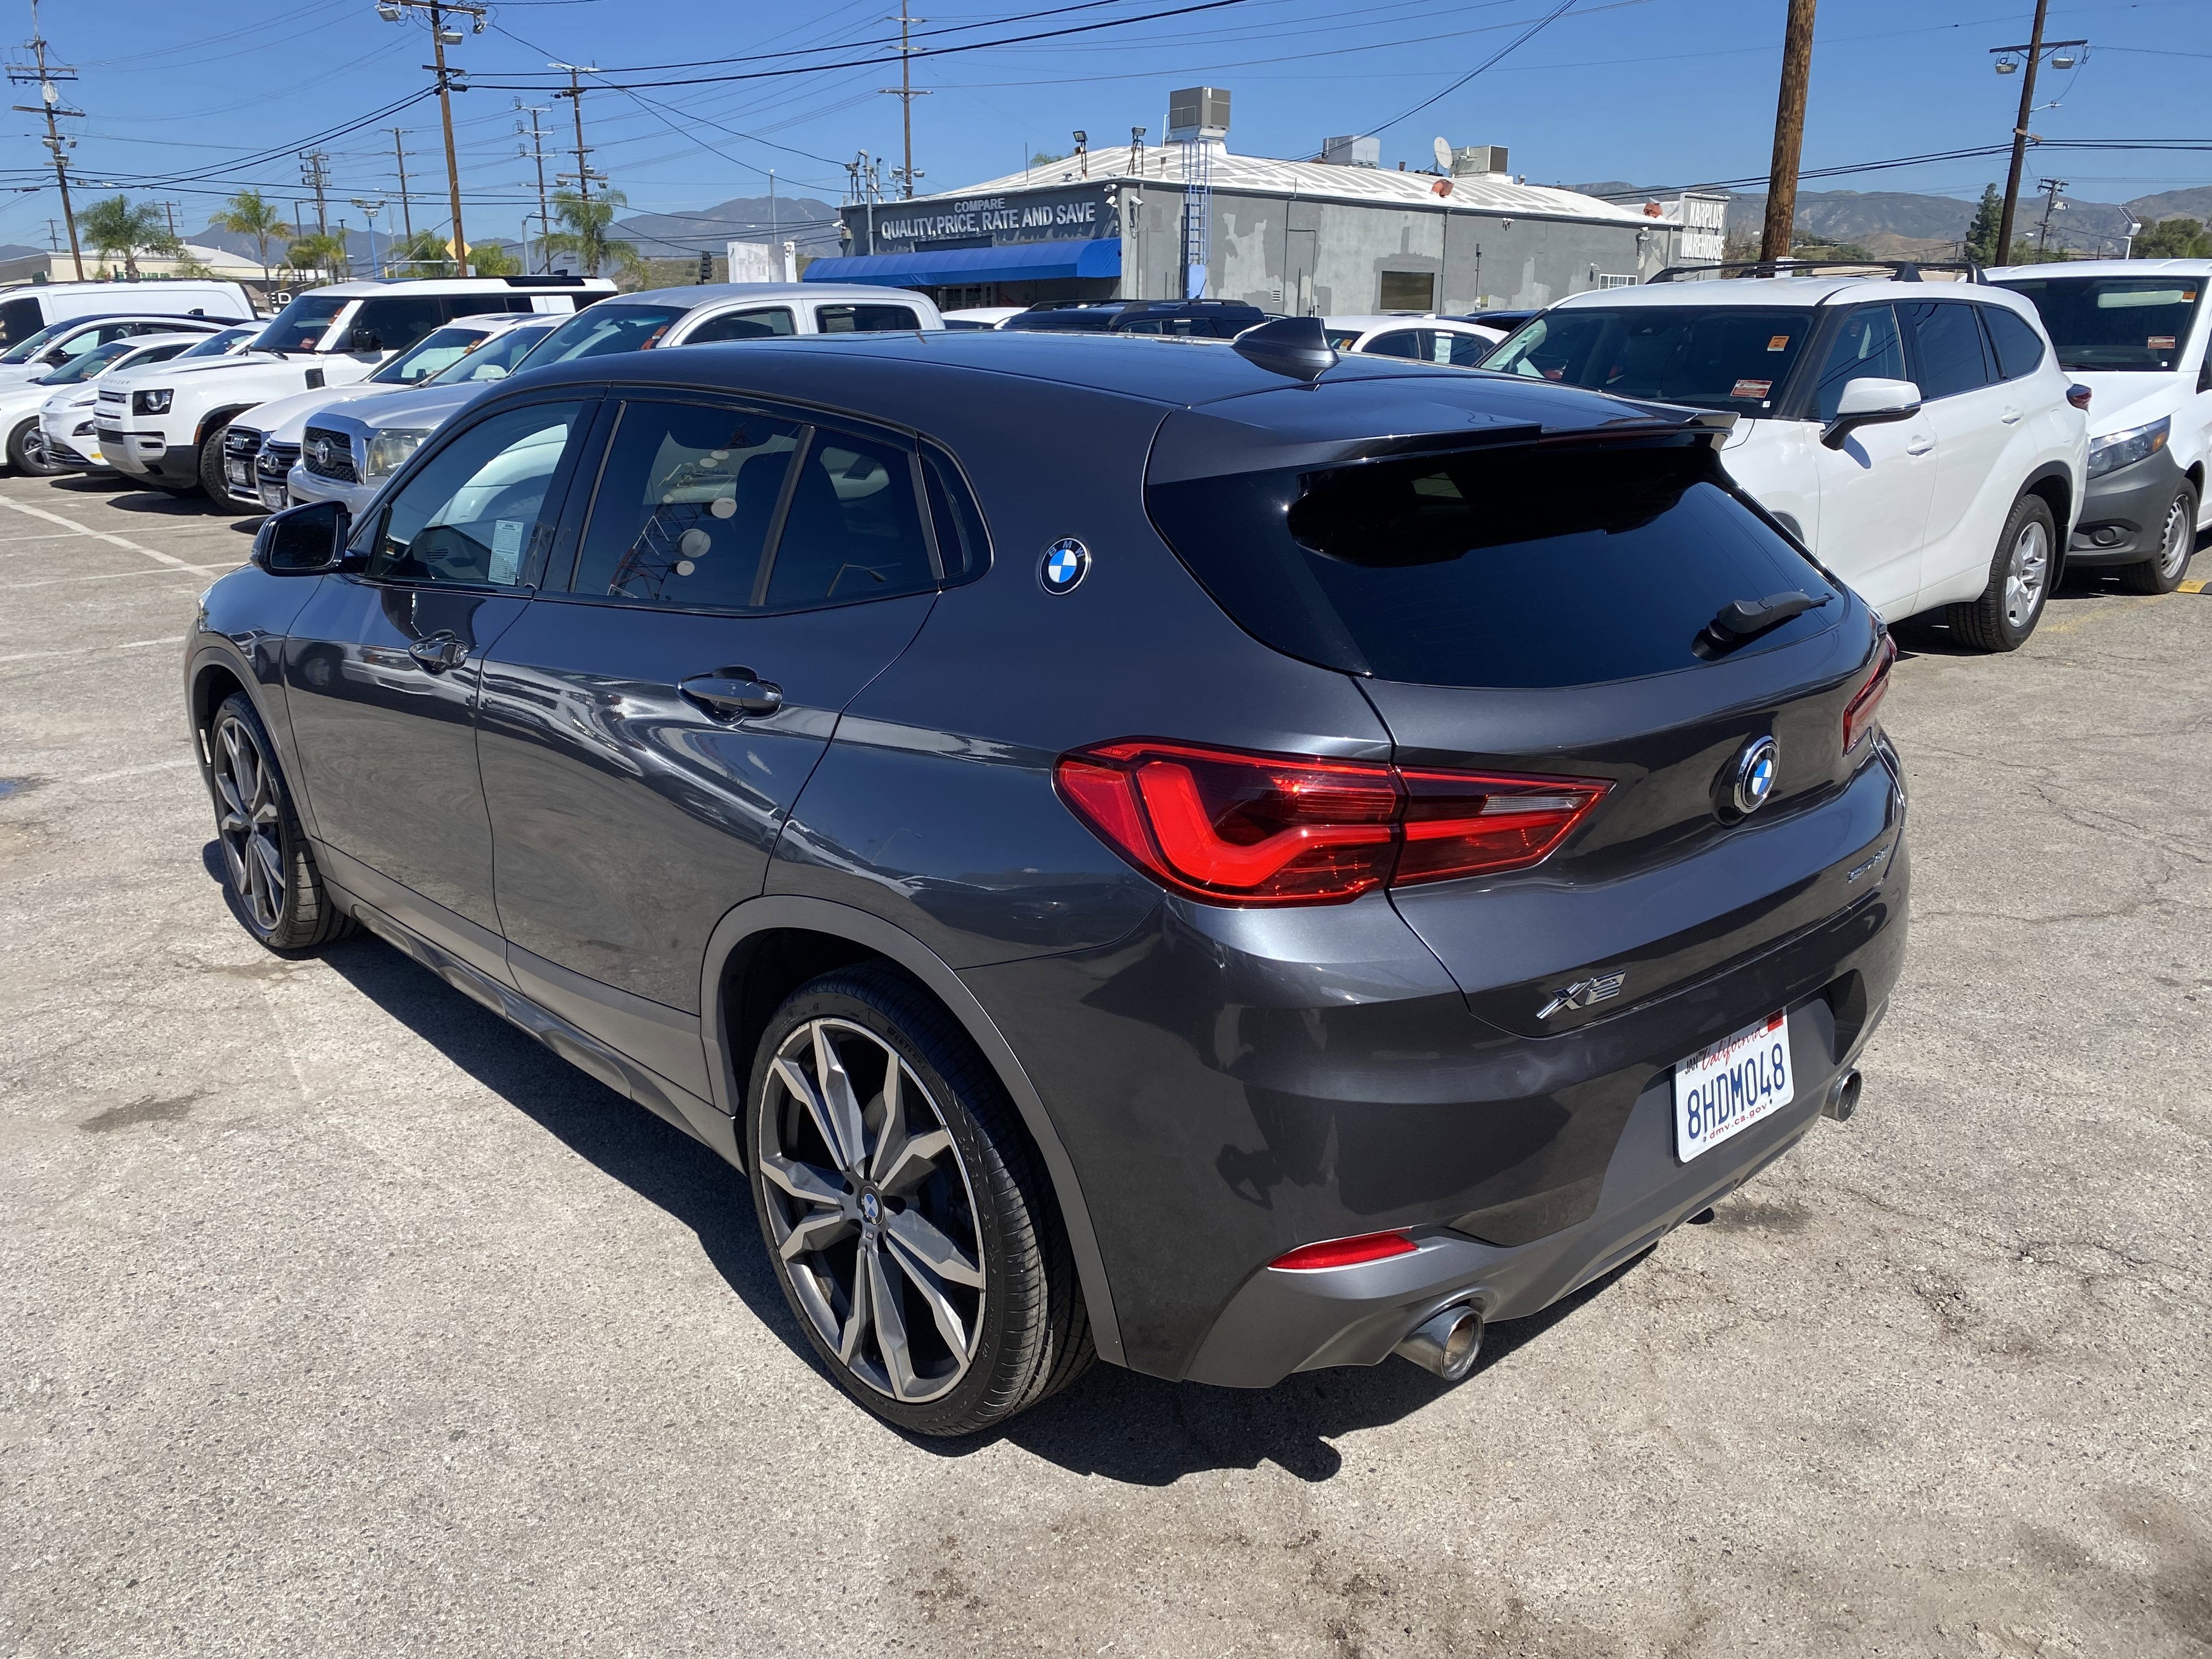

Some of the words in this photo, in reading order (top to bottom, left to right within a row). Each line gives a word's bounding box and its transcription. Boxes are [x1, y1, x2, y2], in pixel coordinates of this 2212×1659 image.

[936, 213, 980, 235] PRICE,
[982, 208, 1019, 231] RATE
[1022, 205, 1053, 228] AND
[1056, 201, 1096, 225] SAVE
[954, 198, 1006, 213] COMPARE
[1689, 202, 1724, 229] KARPLUS
[1681, 233, 1725, 259] WAREHOUSE
[1048, 540, 1086, 558] BMW
[1536, 969, 1626, 1020] X2
[1702, 1026, 1769, 1071] California
[1685, 1054, 1699, 1075] JAN
[1688, 1043, 1785, 1139] 8HDM048
[1709, 1103, 1767, 1139] dmv.ca.gov
